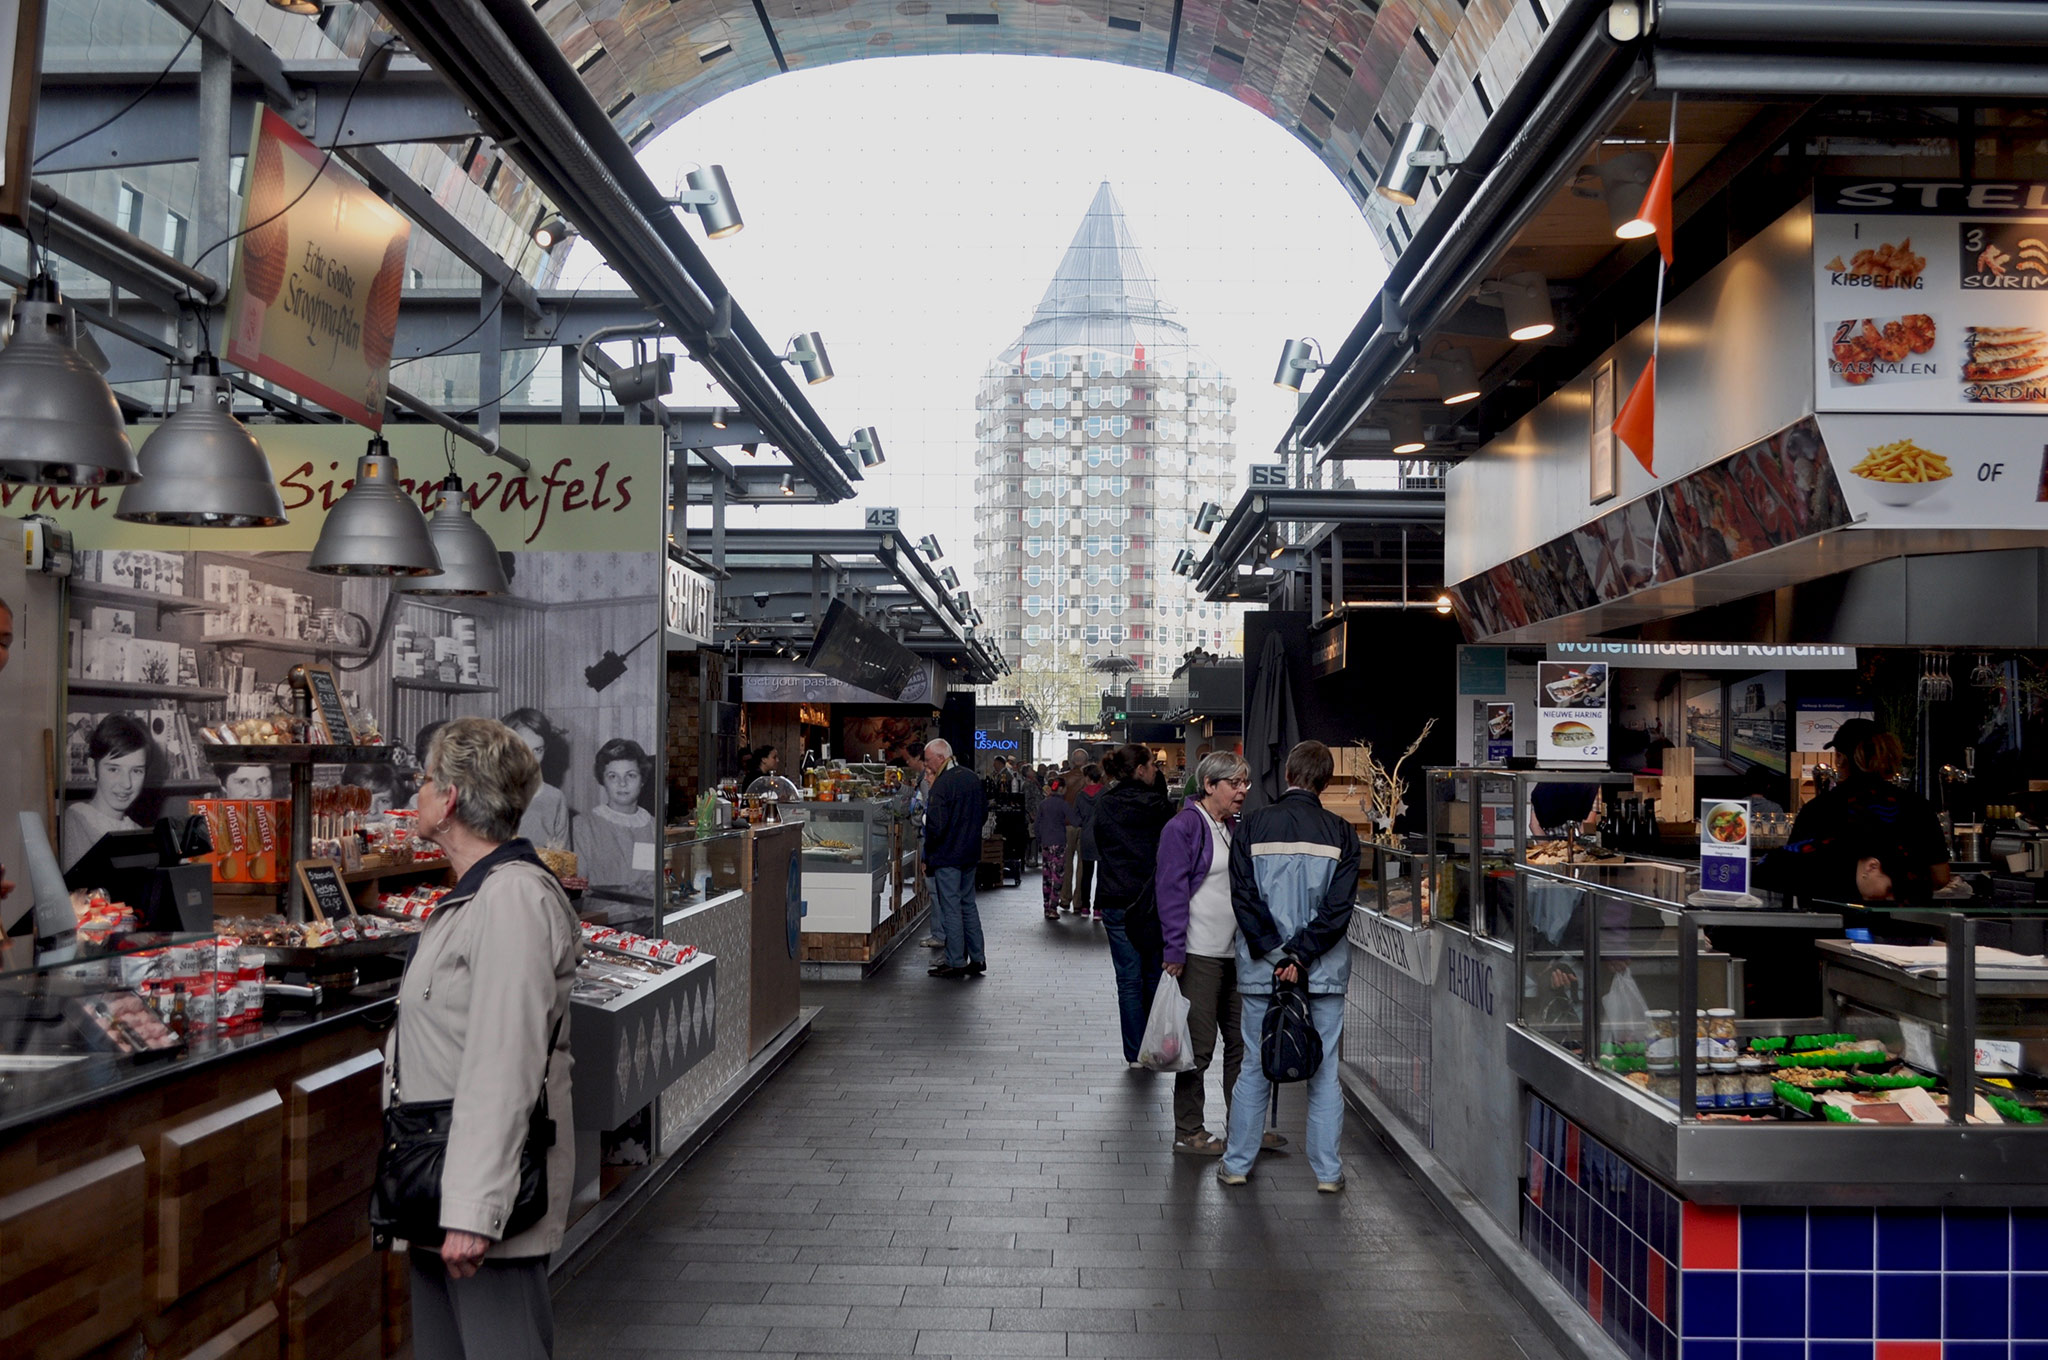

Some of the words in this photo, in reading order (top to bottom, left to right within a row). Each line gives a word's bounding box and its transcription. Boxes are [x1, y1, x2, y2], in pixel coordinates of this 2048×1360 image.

[1965, 229, 1984, 252] 3
[1831, 272, 1924, 290] KIBBELING
[1835, 323, 1851, 344] 2
[1963, 332, 1980, 347] 4
[1832, 362, 1937, 375] GARNALEN
[1963, 386, 2047, 400] SARDIN
[1252, 466, 1286, 485] 65
[1977, 463, 2004, 482] OF
[867, 509, 896, 526] 43
[1543, 711, 1574, 719] NIEUWE
[1575, 711, 1603, 719] HARING
[975, 731, 987, 740] DE
[1448, 947, 1493, 1016] HARING
